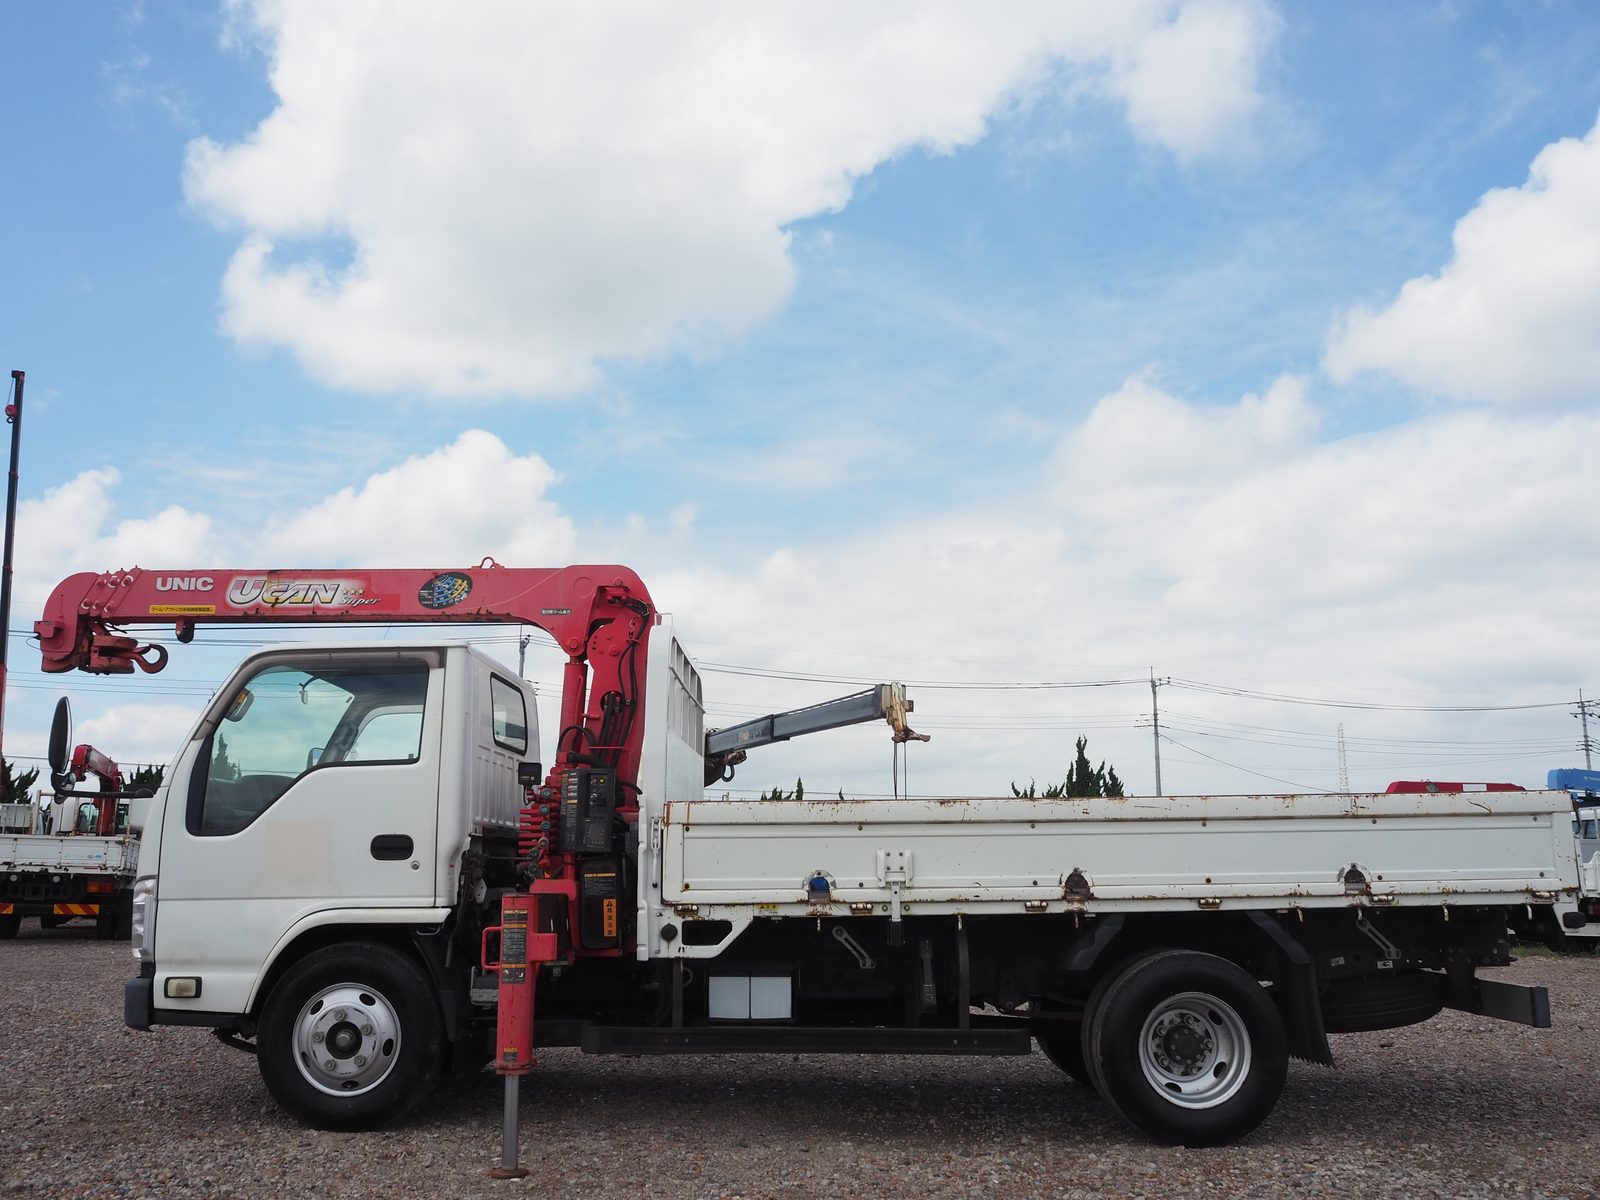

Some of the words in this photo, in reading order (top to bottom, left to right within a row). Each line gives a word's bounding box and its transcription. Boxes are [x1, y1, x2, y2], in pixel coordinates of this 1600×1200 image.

[156, 577, 214, 591] UNIC
[227, 578, 341, 606] UCAN
[339, 596, 381, 607] Super
